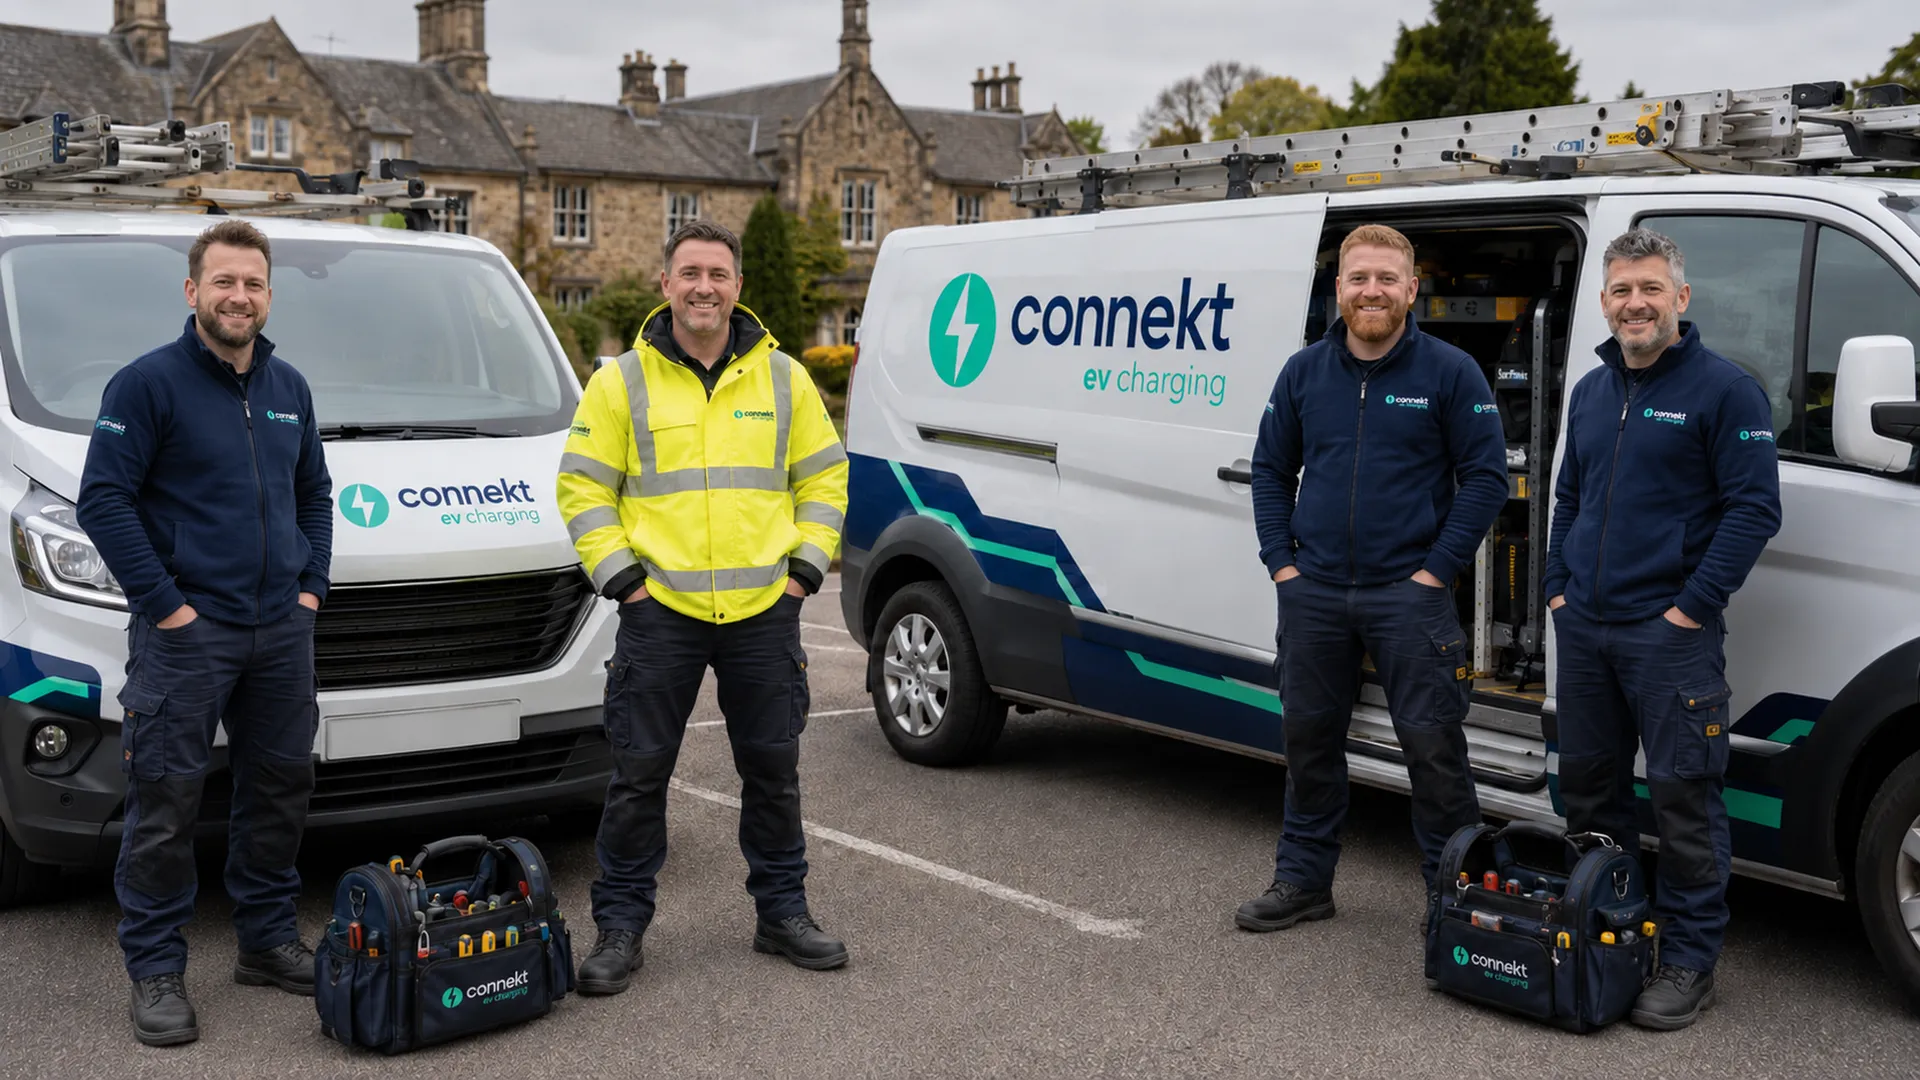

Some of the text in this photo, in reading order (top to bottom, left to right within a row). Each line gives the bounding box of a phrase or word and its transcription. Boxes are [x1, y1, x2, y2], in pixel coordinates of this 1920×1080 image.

[1011, 277, 1235, 351] connekt
[1083, 361, 1226, 406] ev charging
[398, 478, 535, 508] connekt
[441, 507, 540, 525] ev charging
[1471, 953, 1528, 978] connekt
[466, 970, 528, 998] connekt
